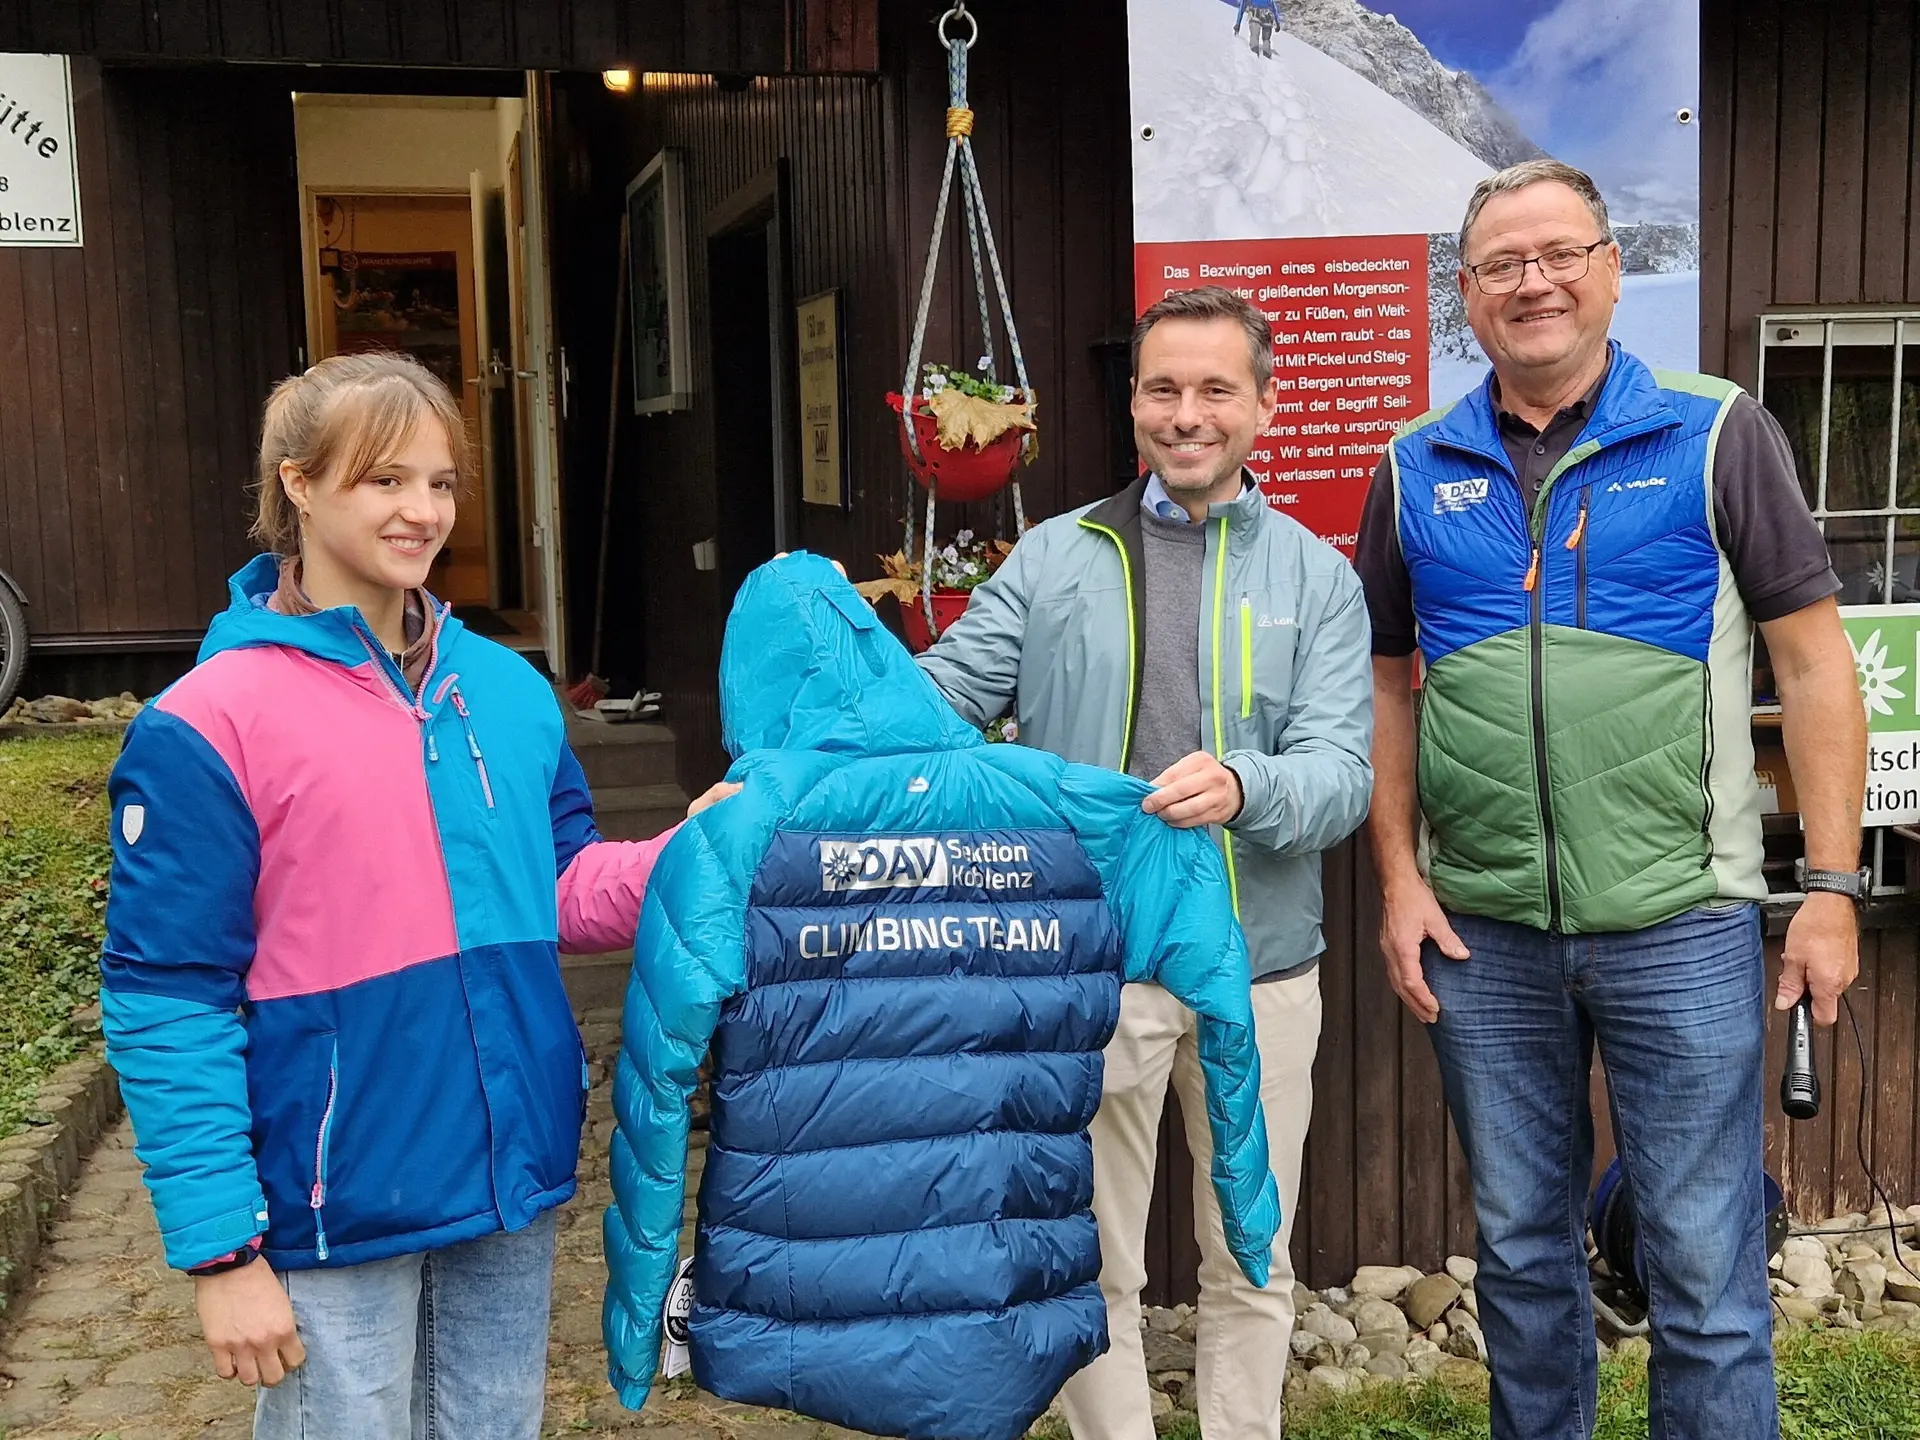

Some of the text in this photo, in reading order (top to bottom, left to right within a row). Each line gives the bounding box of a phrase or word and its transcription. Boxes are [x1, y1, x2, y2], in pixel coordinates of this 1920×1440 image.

[1163, 258, 1410, 279] Das Bezwingen eines eisbedeckten
[1258, 284, 1329, 301] gleißenden
[1333, 282, 1410, 298] Morgenson-
[1285, 310, 1301, 321] zu
[1305, 306, 1349, 320] Füßen,
[1353, 305, 1373, 318] ein
[1377, 303, 1410, 317] Weit-
[1274, 331, 1299, 345] den
[1303, 330, 1337, 343] Atem
[1341, 328, 1374, 342] raubt
[1387, 327, 1411, 340] das
[1285, 353, 1306, 367] Mit
[1308, 351, 1346, 366] Pickel
[1348, 350, 1372, 364] und
[1373, 349, 1411, 366] Steig-
[1298, 376, 1344, 392] Bergen
[1345, 374, 1411, 389] unterwegs
[1309, 398, 1330, 412] der
[1336, 396, 1378, 413] Begriff
[1383, 394, 1411, 408] Seil-
[1262, 425, 1297, 438] seine
[1301, 421, 1340, 436] starke
[1280, 445, 1302, 459] Wir
[1307, 444, 1333, 458] sind
[1275, 467, 1335, 483] verlassen
[1341, 467, 1364, 478] uns
[1626, 477, 1667, 489] VAUDE
[1451, 481, 1485, 498] DAV
[1265, 493, 1299, 505] rtner.
[857, 838, 1029, 883] DAV Sektion
[952, 864, 1033, 890] Koblenz
[799, 916, 1060, 960] CLIMBING TEAM
